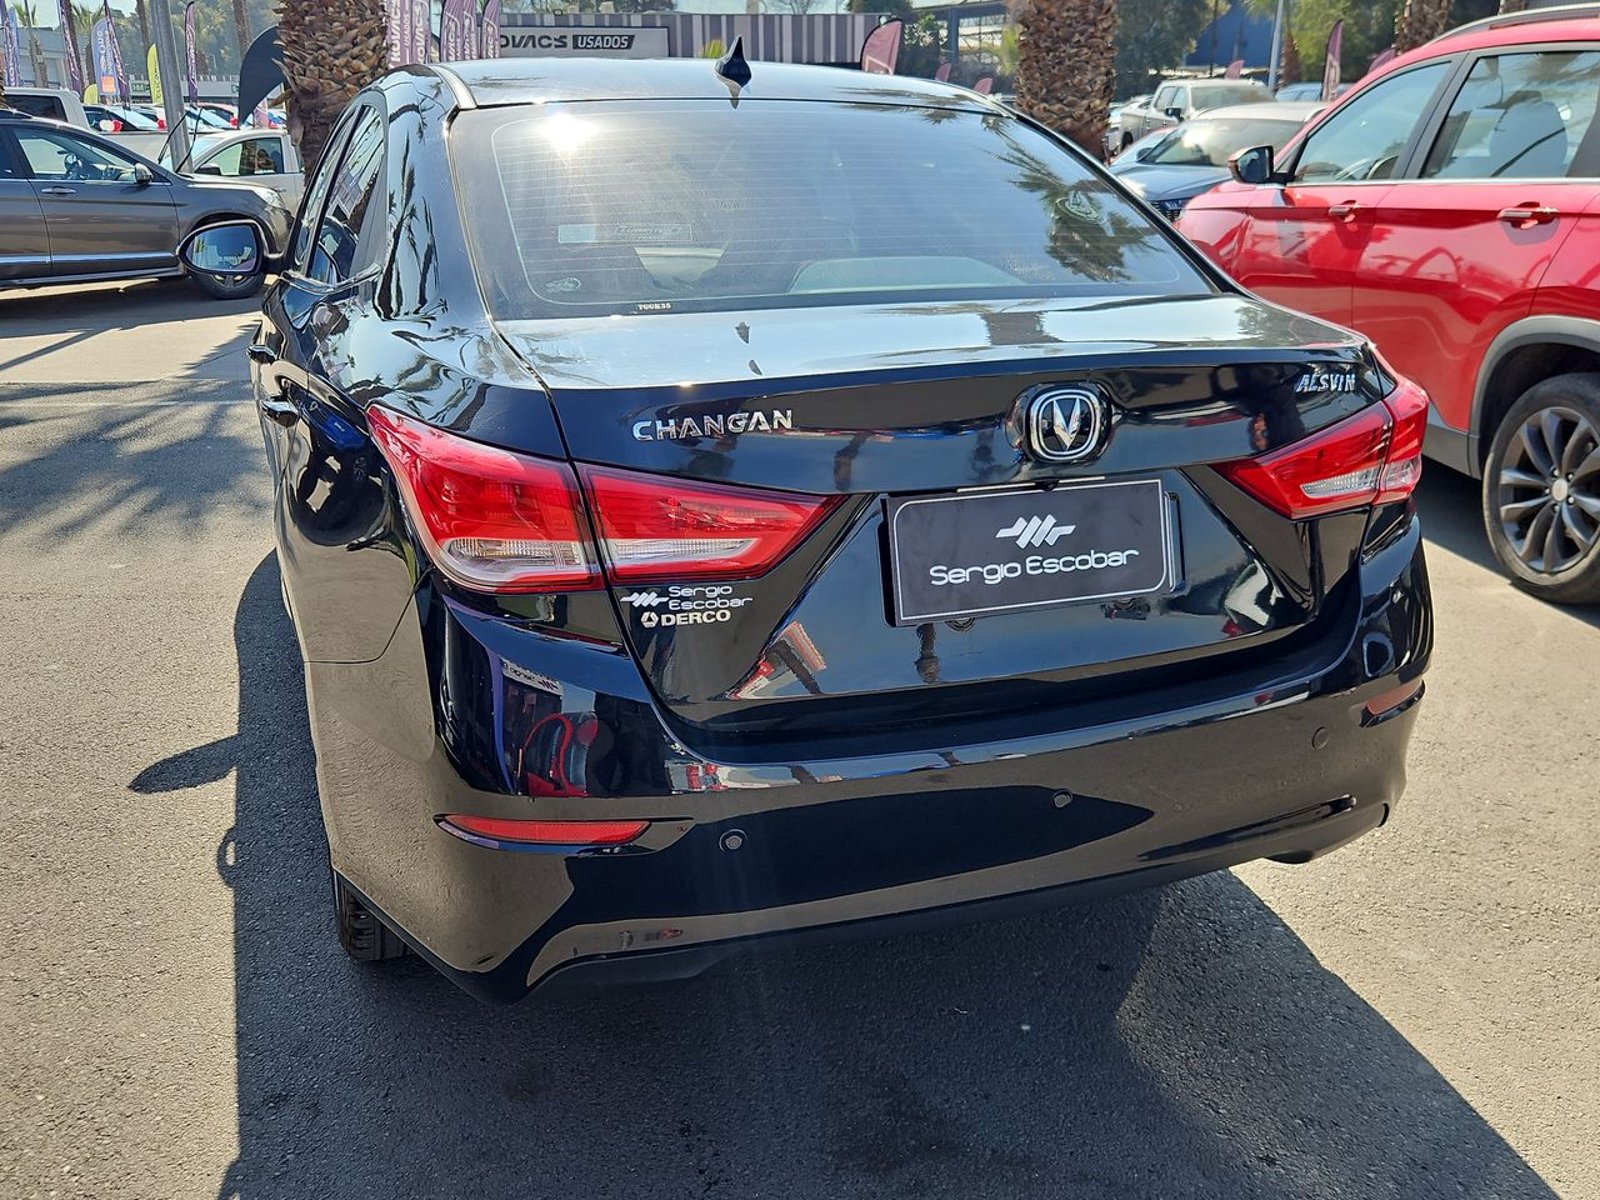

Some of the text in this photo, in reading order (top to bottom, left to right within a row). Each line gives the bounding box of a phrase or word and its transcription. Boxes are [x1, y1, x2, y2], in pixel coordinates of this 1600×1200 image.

[500, 34, 568, 49] OVACS
[577, 35, 630, 49] USADOS
[1295, 373, 1356, 393] ALSVIN
[632, 409, 793, 441] CHANGAN
[929, 549, 1140, 586] Sergio Escobar
[668, 585, 733, 598] Sergio
[668, 597, 754, 611] Escobar
[660, 609, 732, 627] DERCO
